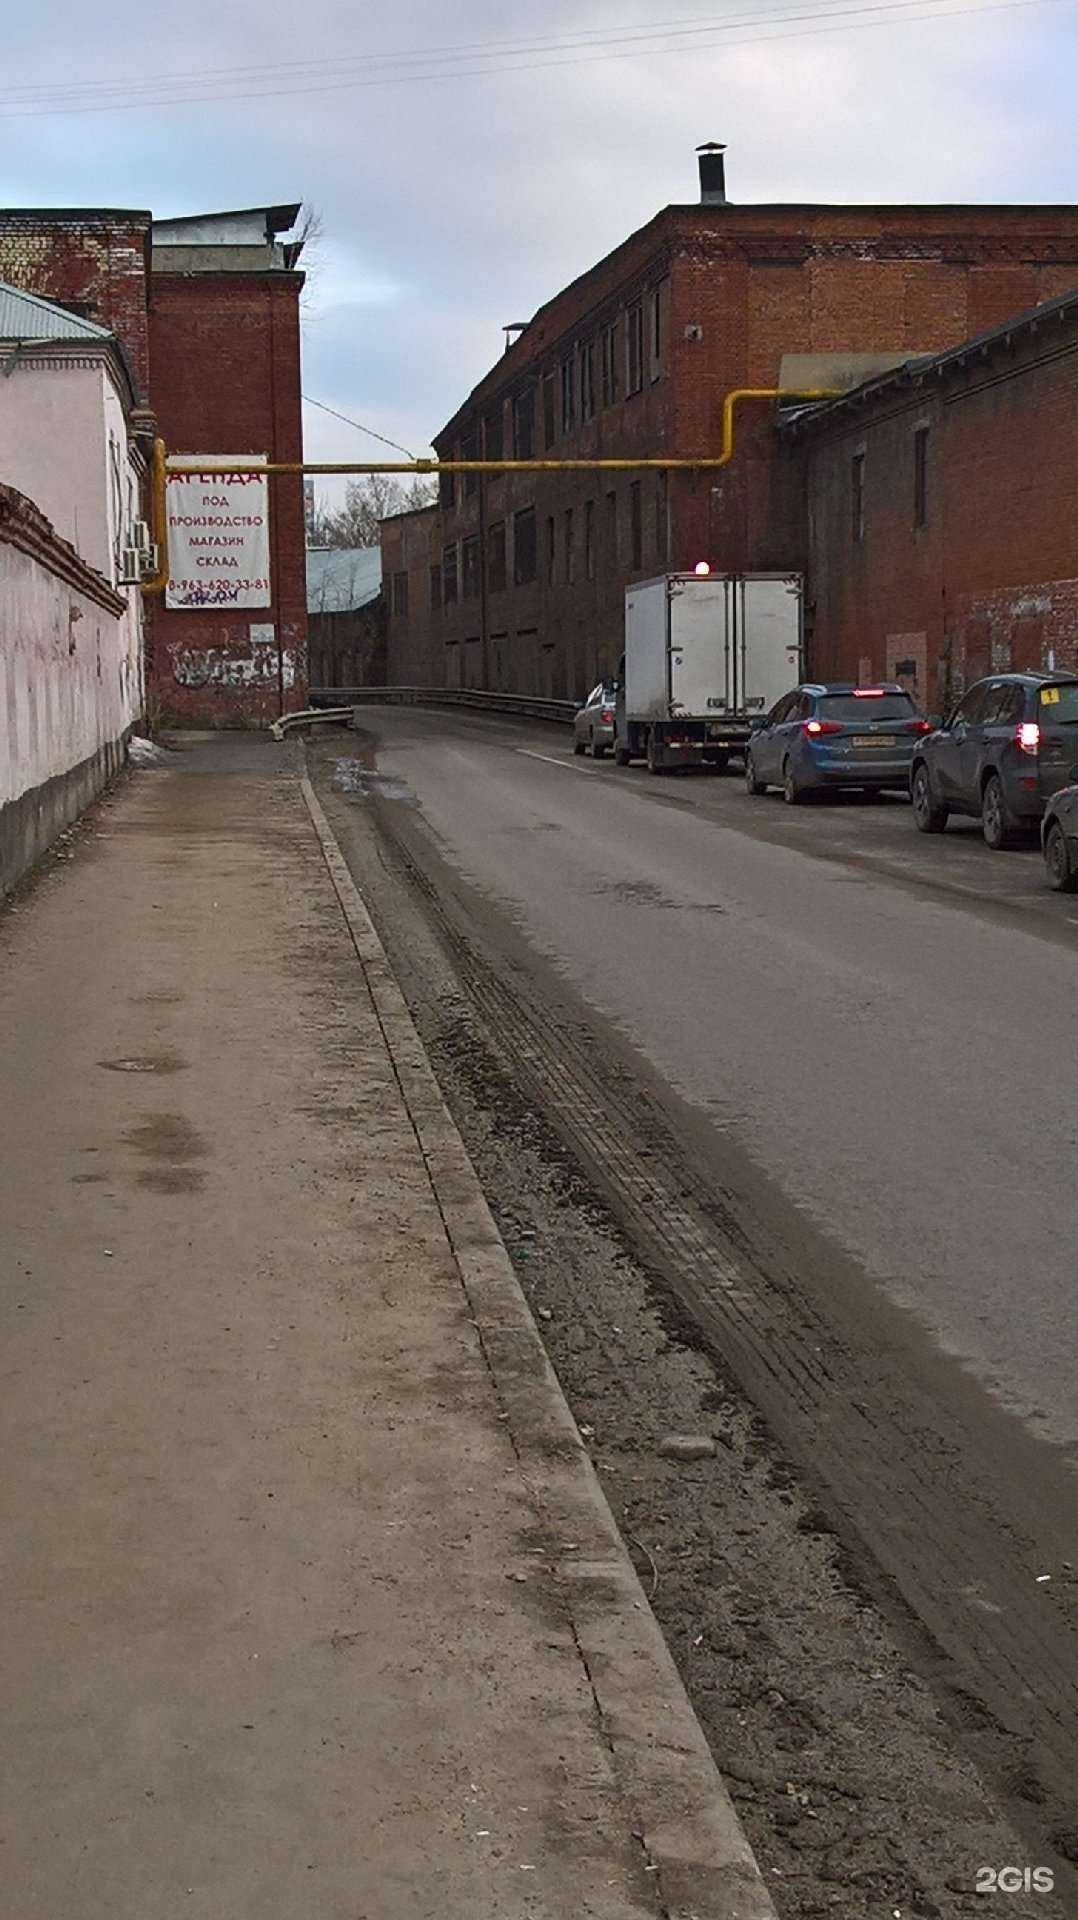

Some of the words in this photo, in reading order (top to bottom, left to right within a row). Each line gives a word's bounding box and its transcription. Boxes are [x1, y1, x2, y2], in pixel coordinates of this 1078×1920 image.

[202, 496, 229, 506] ПОД
[169, 516, 263, 526] ПРОИЗВОДСТВО
[189, 537, 244, 546] МАГАЗИН
[196, 557, 238, 567] СКЛАД
